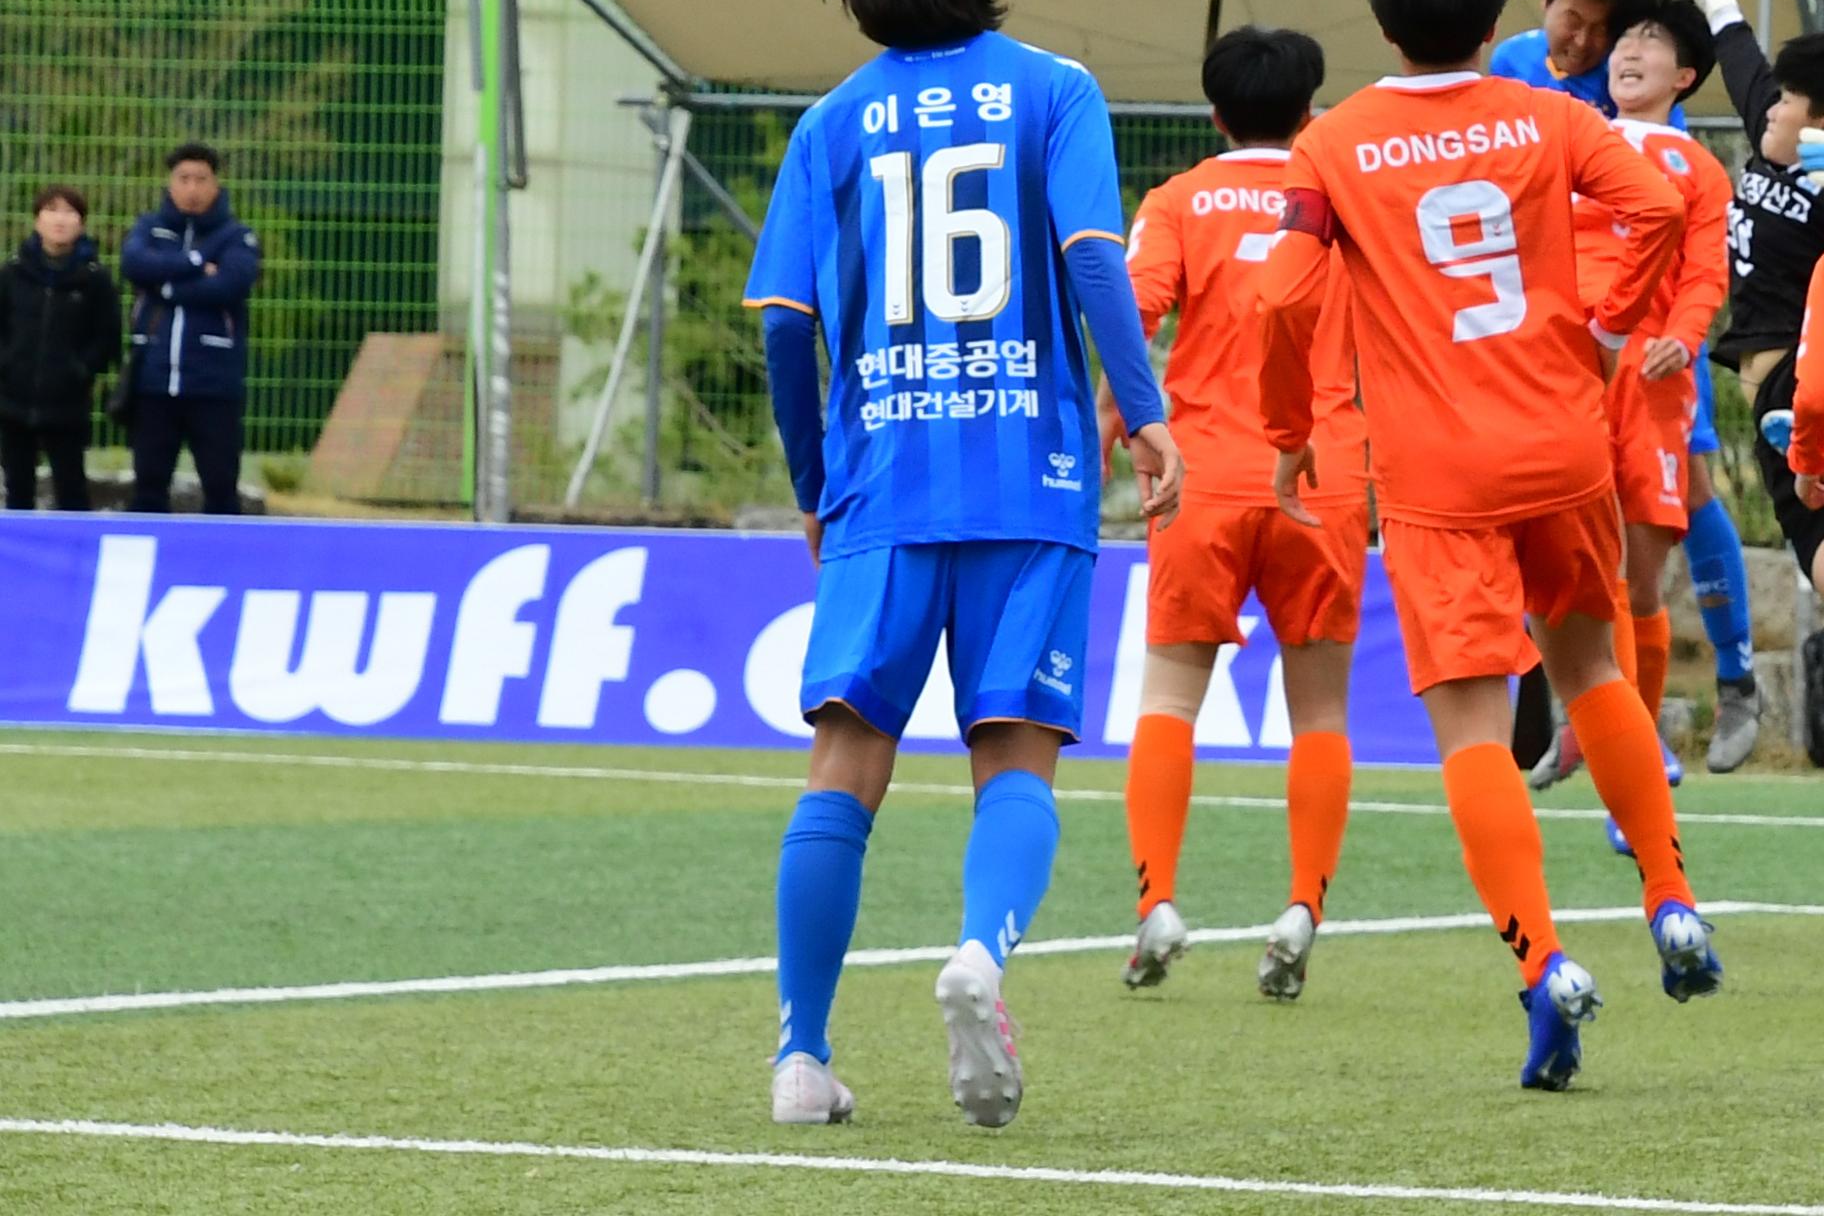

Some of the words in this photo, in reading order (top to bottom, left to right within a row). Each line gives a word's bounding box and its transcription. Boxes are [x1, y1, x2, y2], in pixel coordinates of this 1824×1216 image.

[863, 83, 1012, 133] 이은영
[1355, 115, 1541, 173] DONGSAN
[1192, 187, 1287, 220] DONG
[870, 142, 1011, 325] 16
[1415, 180, 1527, 343] 9
[855, 340, 1037, 390] 현대중공업
[860, 389, 1039, 431] 현대건설기계
